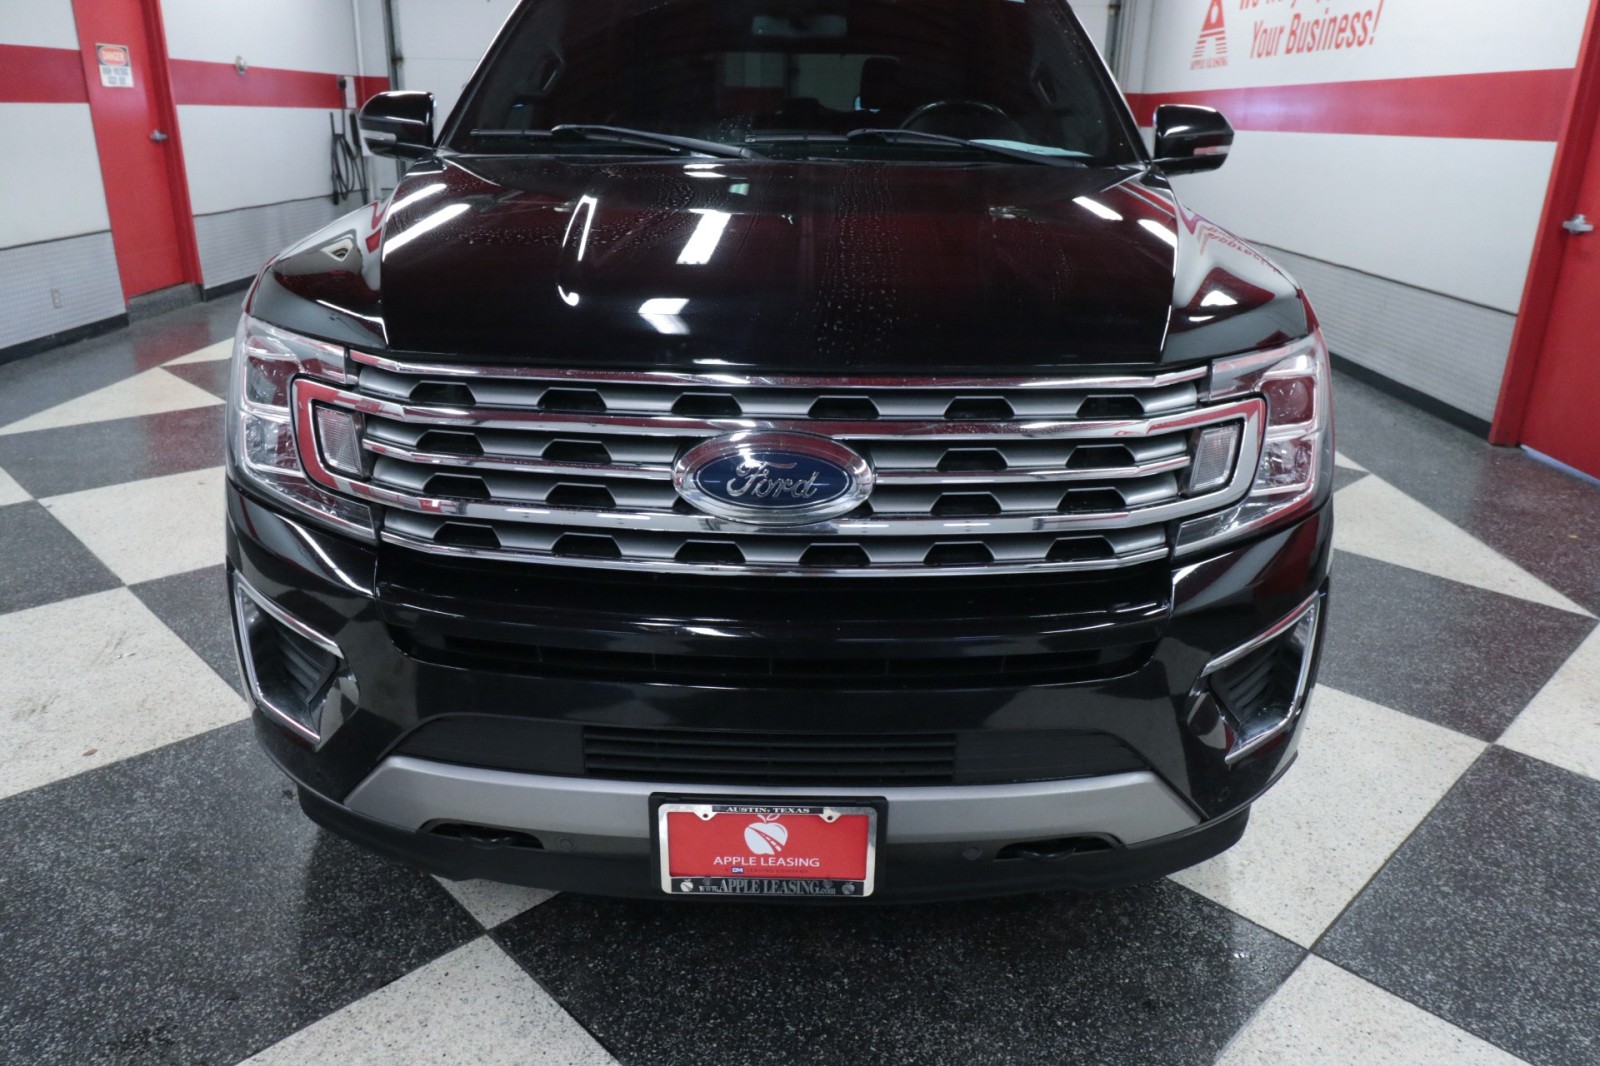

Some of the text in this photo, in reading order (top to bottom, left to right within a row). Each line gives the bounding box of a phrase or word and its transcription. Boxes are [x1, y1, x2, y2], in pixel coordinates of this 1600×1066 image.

[1250, 0, 1384, 59] Your Business!
[726, 460, 820, 498] Ford
[713, 856, 820, 868] APPLE LEASING
